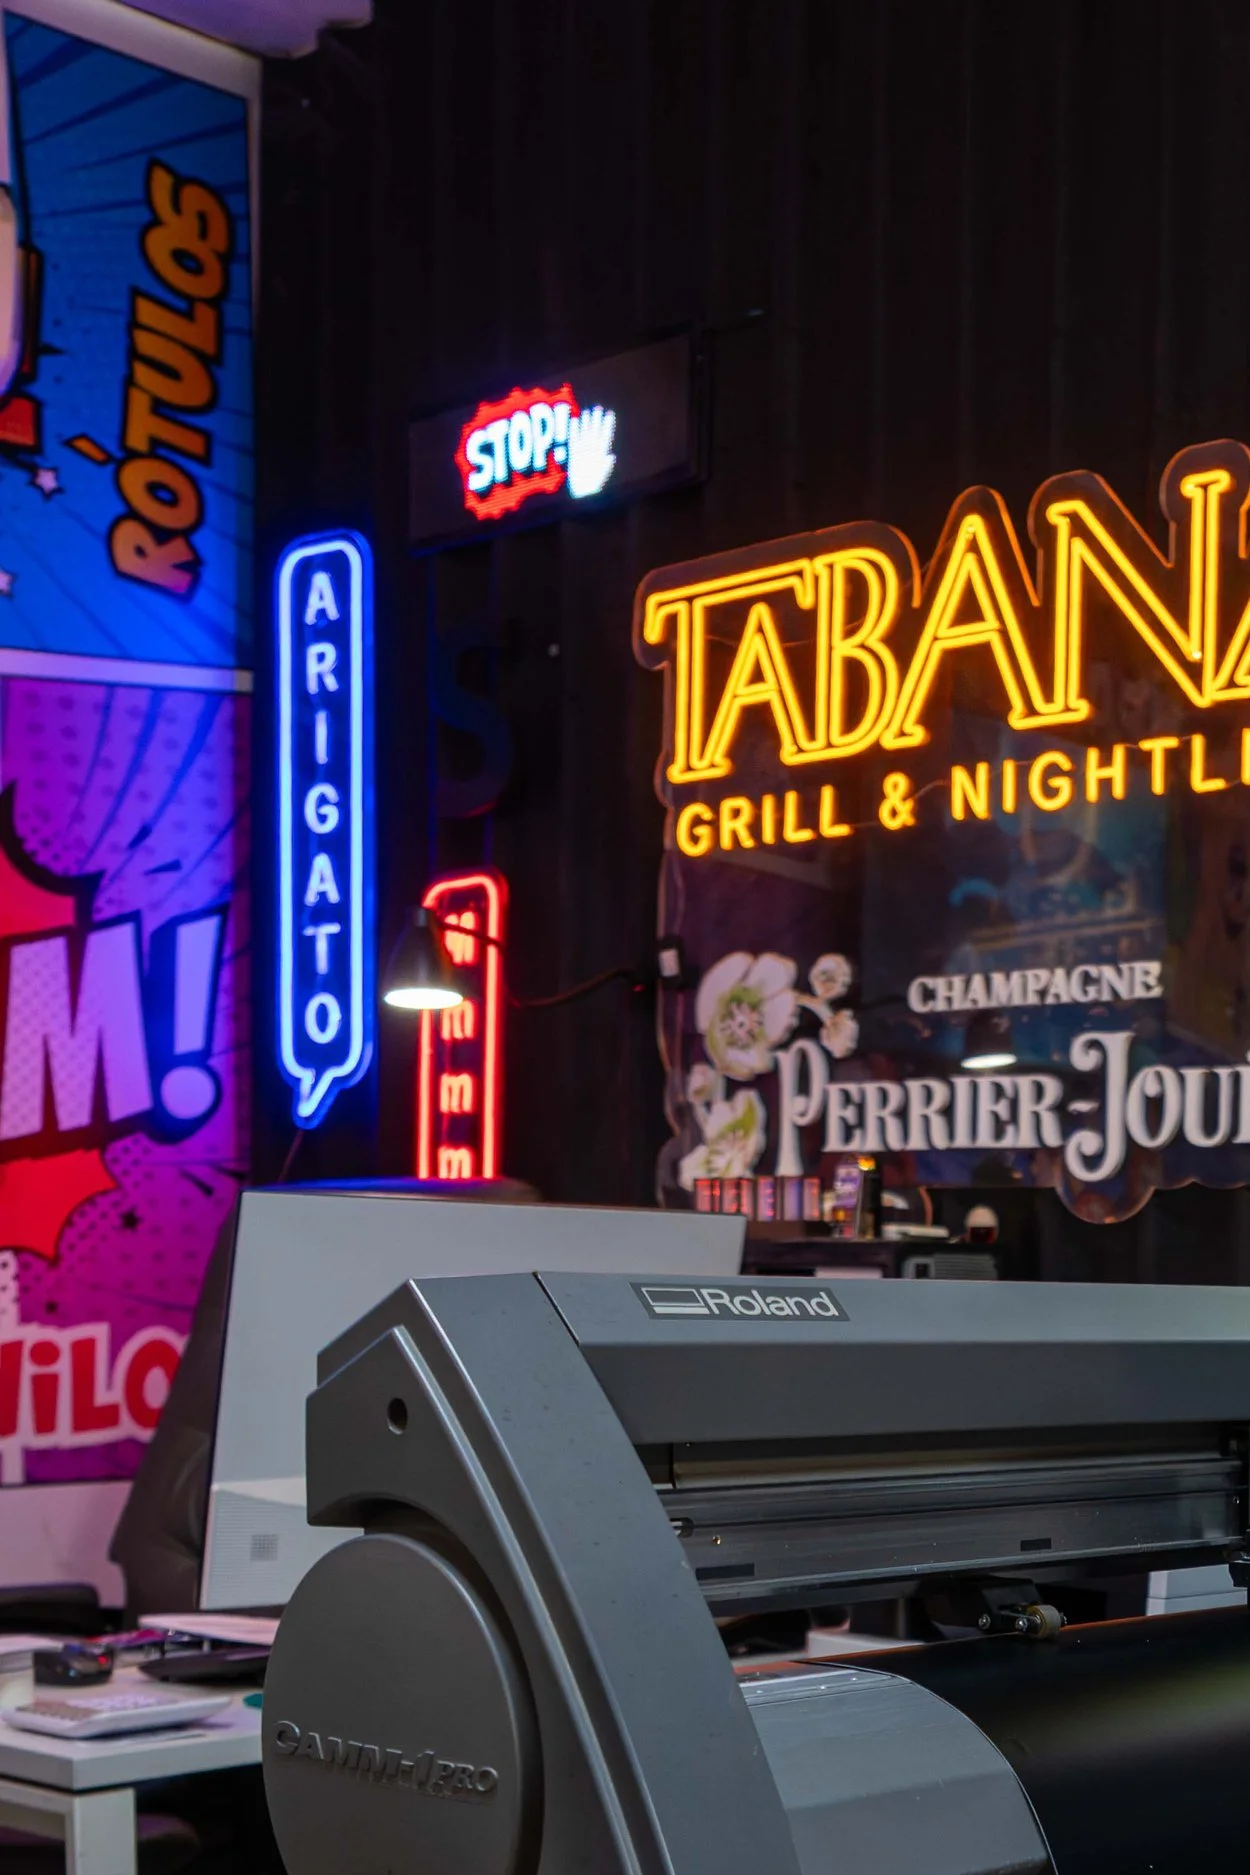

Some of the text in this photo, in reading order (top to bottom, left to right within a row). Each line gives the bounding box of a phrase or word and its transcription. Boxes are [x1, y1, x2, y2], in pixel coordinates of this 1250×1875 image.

[66, 158, 231, 598] RÓTULOS
[466, 402, 571, 491] STOP!
[304, 571, 342, 1045] ARIGATO
[676, 784, 851, 857] GRILL
[878, 772, 917, 828] &
[907, 960, 1163, 1014] CHAMPAGNE
[699, 1288, 840, 1317] Roland
